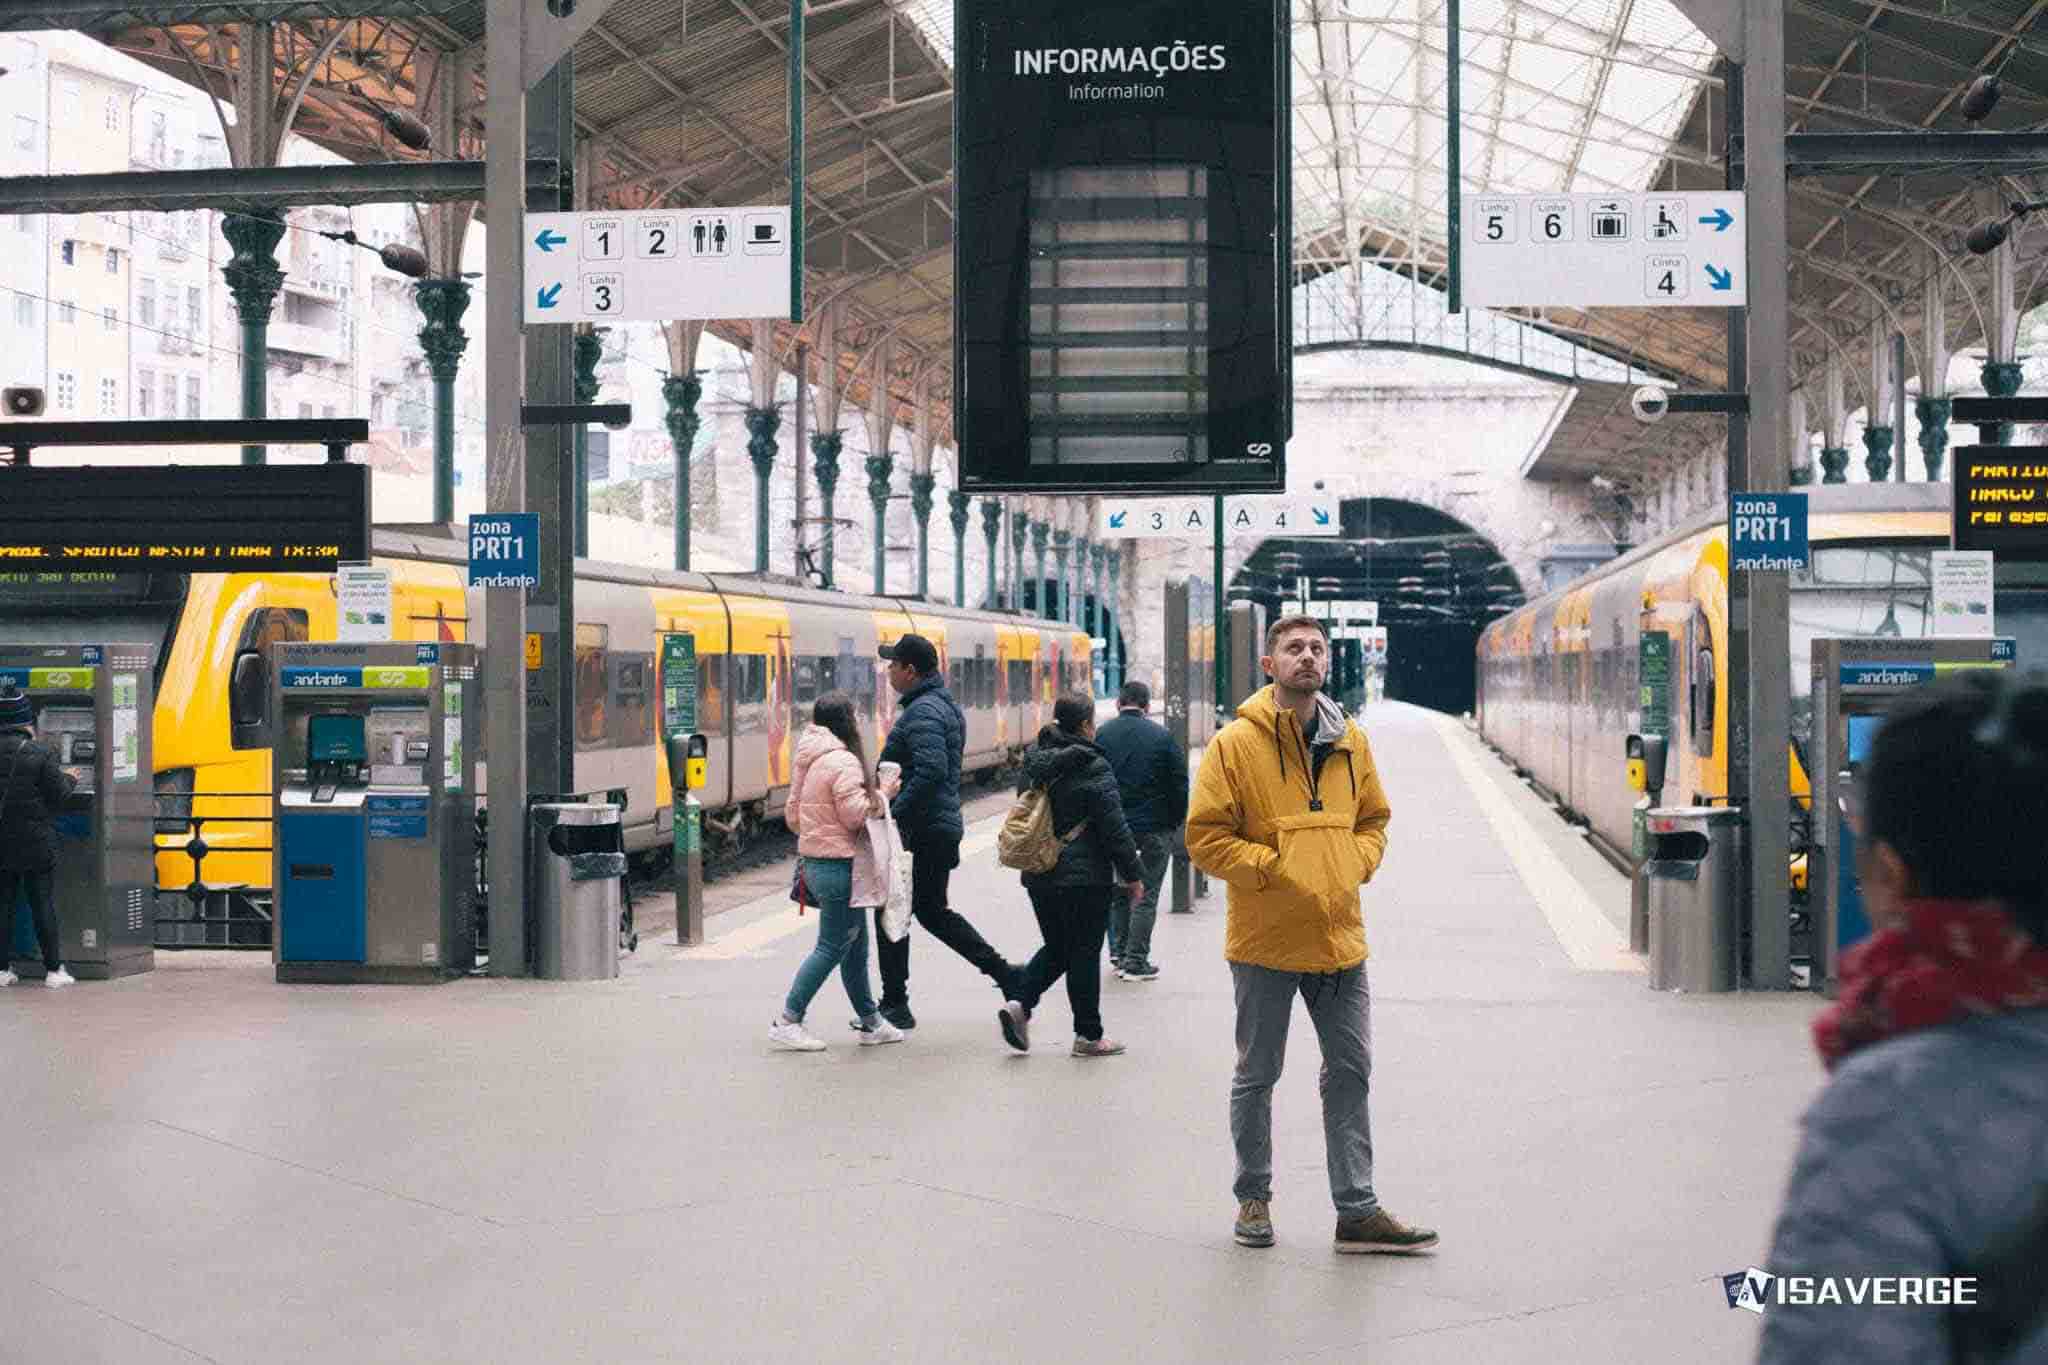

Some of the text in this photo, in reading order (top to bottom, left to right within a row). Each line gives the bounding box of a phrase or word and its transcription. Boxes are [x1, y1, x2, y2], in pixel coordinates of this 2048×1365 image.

[1015, 40, 1226, 78] INFORMAÇÕES
[1069, 83, 1164, 100] Information
[1481, 203, 1509, 213] Linha
[1538, 203, 1566, 213] Linha
[590, 221, 617, 230] Linha
[643, 220, 670, 229] Linha
[1487, 215, 1503, 240] 5
[1544, 213, 1562, 239] 6
[597, 231, 609, 256] 1
[649, 229, 665, 255] 2
[1652, 256, 1681, 267] Linha
[590, 276, 617, 285] Linha
[1657, 271, 1675, 295] 4
[595, 285, 611, 311] 3
[1235, 508, 1251, 526] A
[1735, 501, 1777, 515] zona
[1151, 512, 1163, 530] 3
[1187, 509, 1202, 527] A
[1275, 512, 1287, 528] 4
[472, 521, 512, 535] zona
[1735, 516, 1791, 542] PRT1
[472, 535, 524, 561] PRT1
[1735, 553, 1804, 571] andante
[473, 571, 536, 590] andante
[293, 671, 348, 686] andante
[1857, 668, 1919, 685] andante
